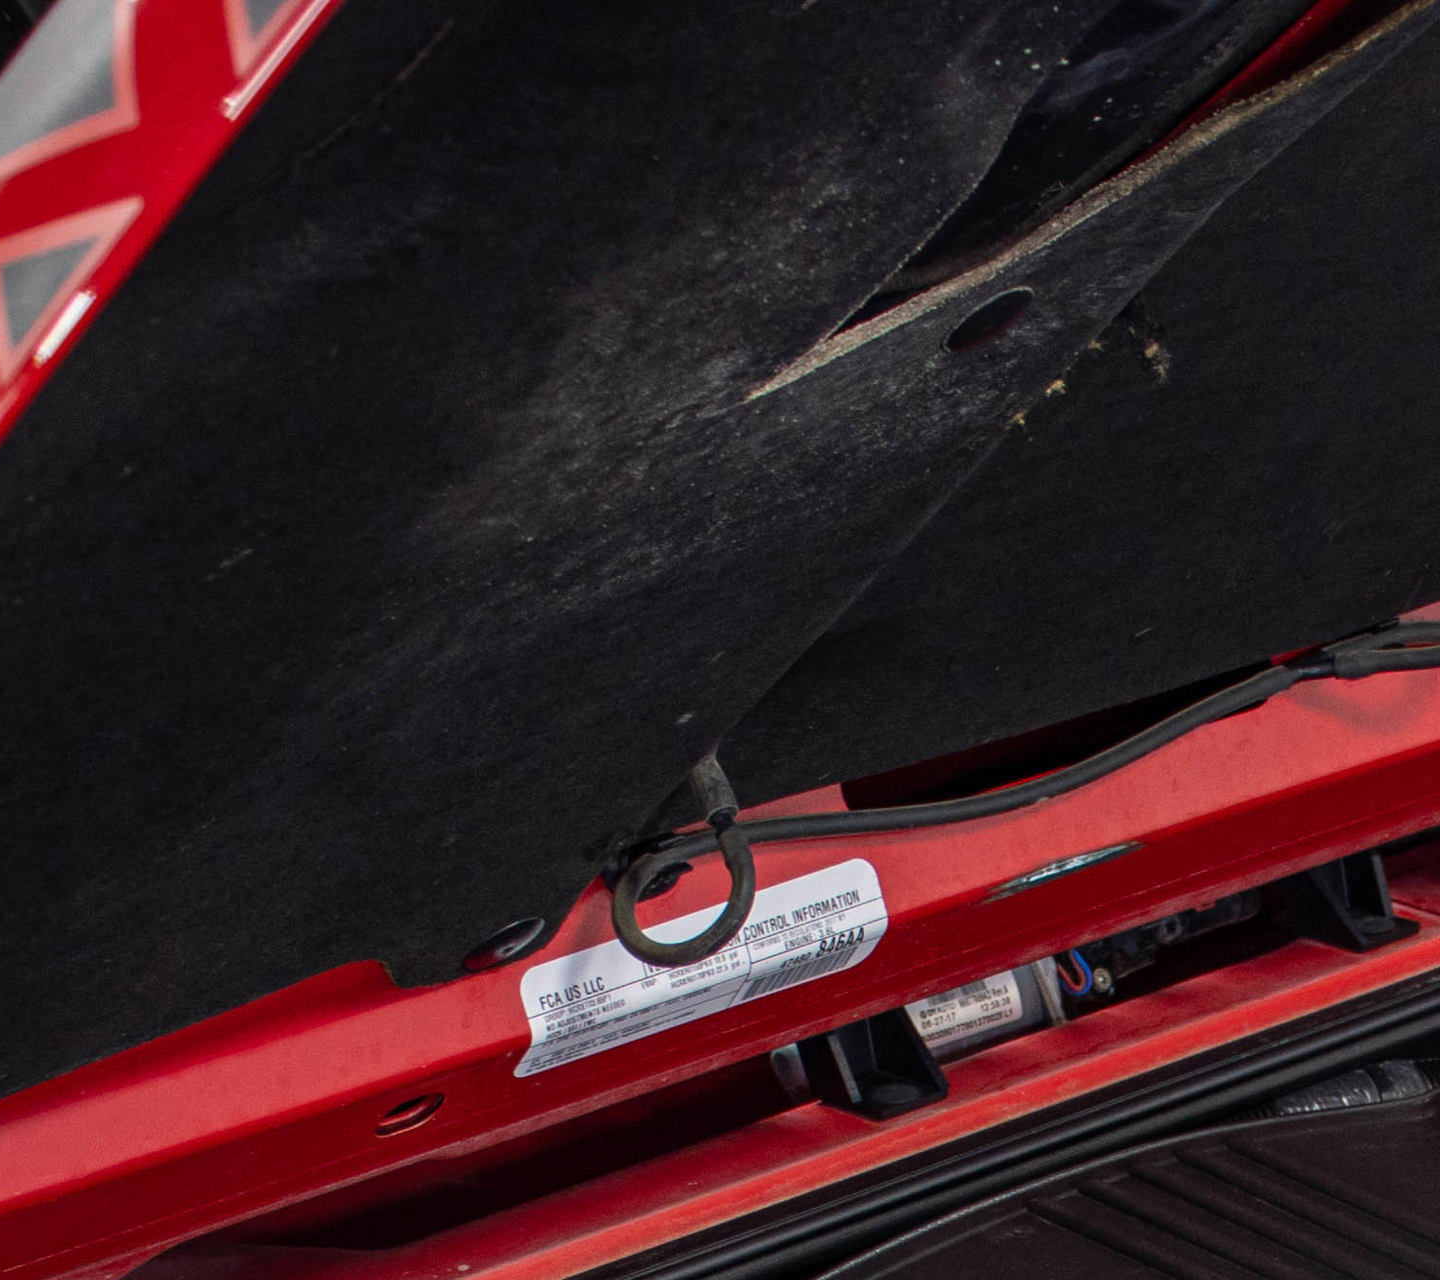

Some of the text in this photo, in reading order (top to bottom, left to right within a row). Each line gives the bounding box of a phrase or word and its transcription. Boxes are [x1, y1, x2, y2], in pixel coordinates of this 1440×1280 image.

[743, 888, 861, 940] CONTROL INFORMATION
[540, 989, 562, 1012] FCA
[566, 983, 580, 1002] US
[585, 974, 604, 996] LLC
